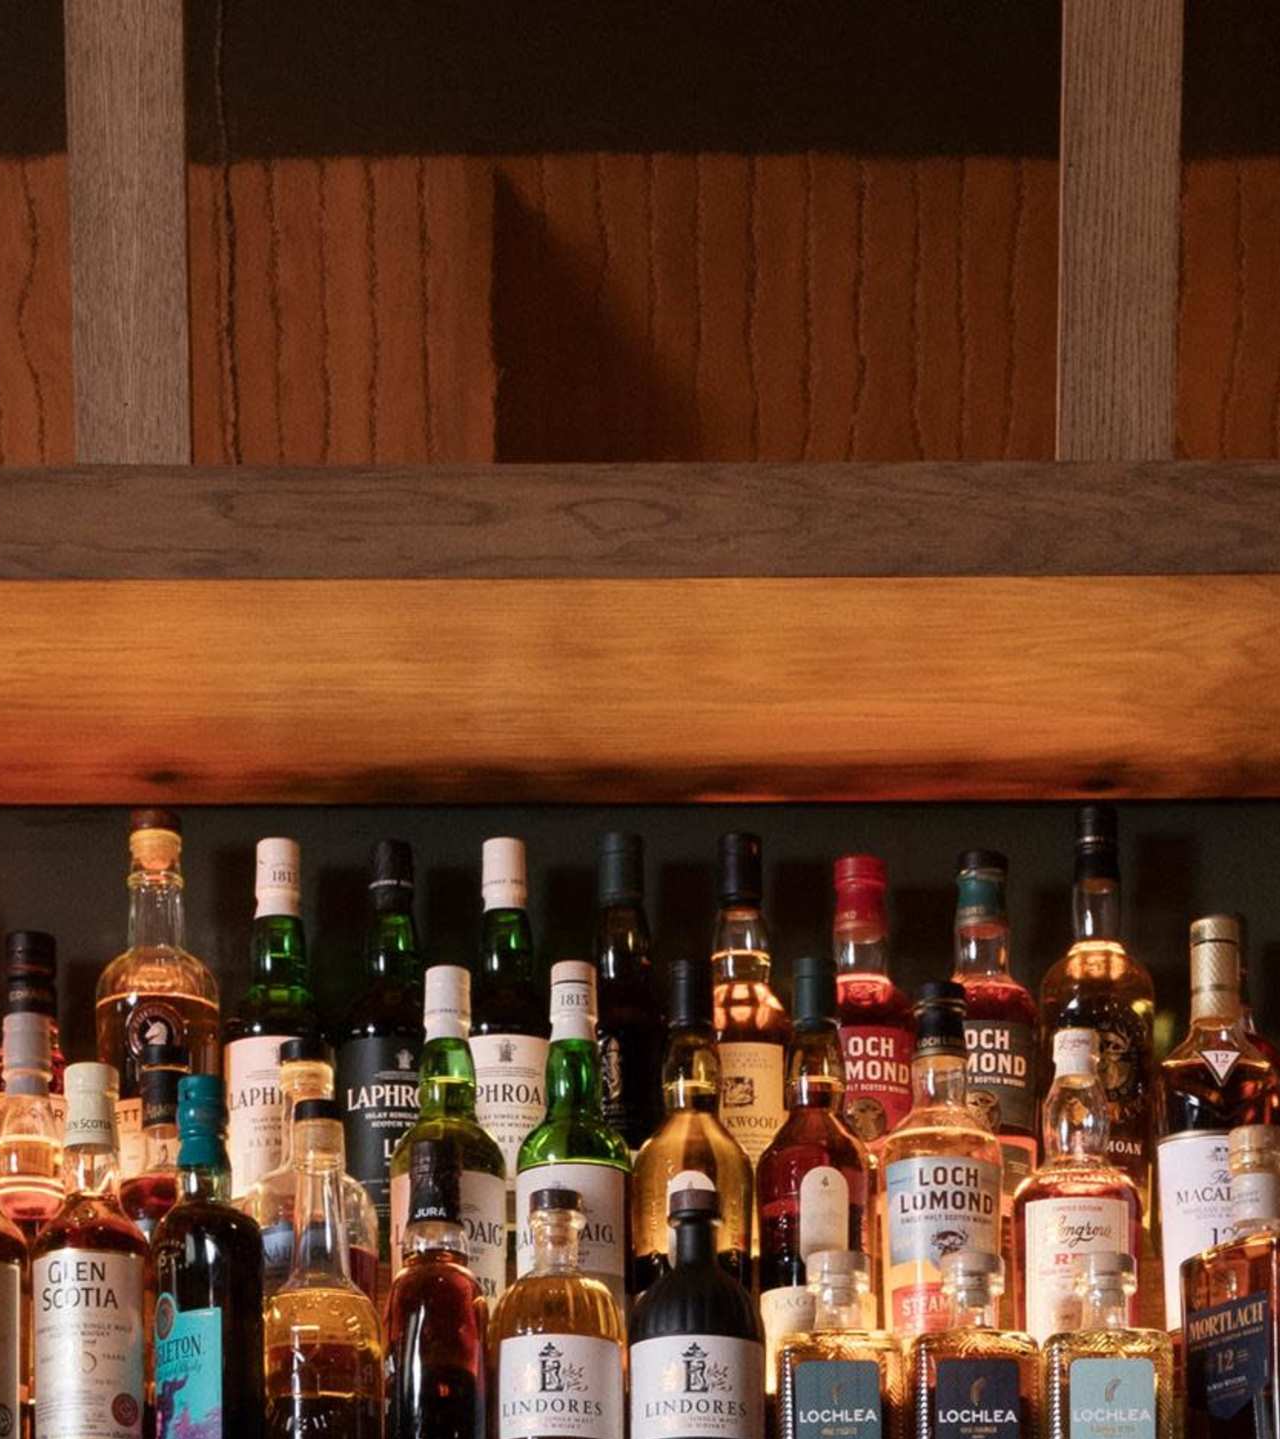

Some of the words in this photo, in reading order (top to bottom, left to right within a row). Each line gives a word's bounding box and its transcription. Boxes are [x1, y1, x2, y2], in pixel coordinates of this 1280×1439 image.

[843, 1036, 894, 1058] OCH
[845, 1060, 910, 1084] MOND
[919, 1165, 979, 1187] LOCH
[414, 1207, 448, 1219] JURA
[899, 1190, 994, 1215] LOMOND
[47, 1260, 107, 1285] GLEN
[41, 1287, 119, 1312] SCOTIA
[1188, 1300, 1267, 1341] MORTLACH
[502, 1398, 603, 1418] LINDORES
[645, 1398, 747, 1418] LINDORES
[798, 1408, 878, 1424] LOCHLEA
[938, 1408, 1018, 1424] LOCHLEA
[1072, 1408, 1152, 1423] LOCHLEA
